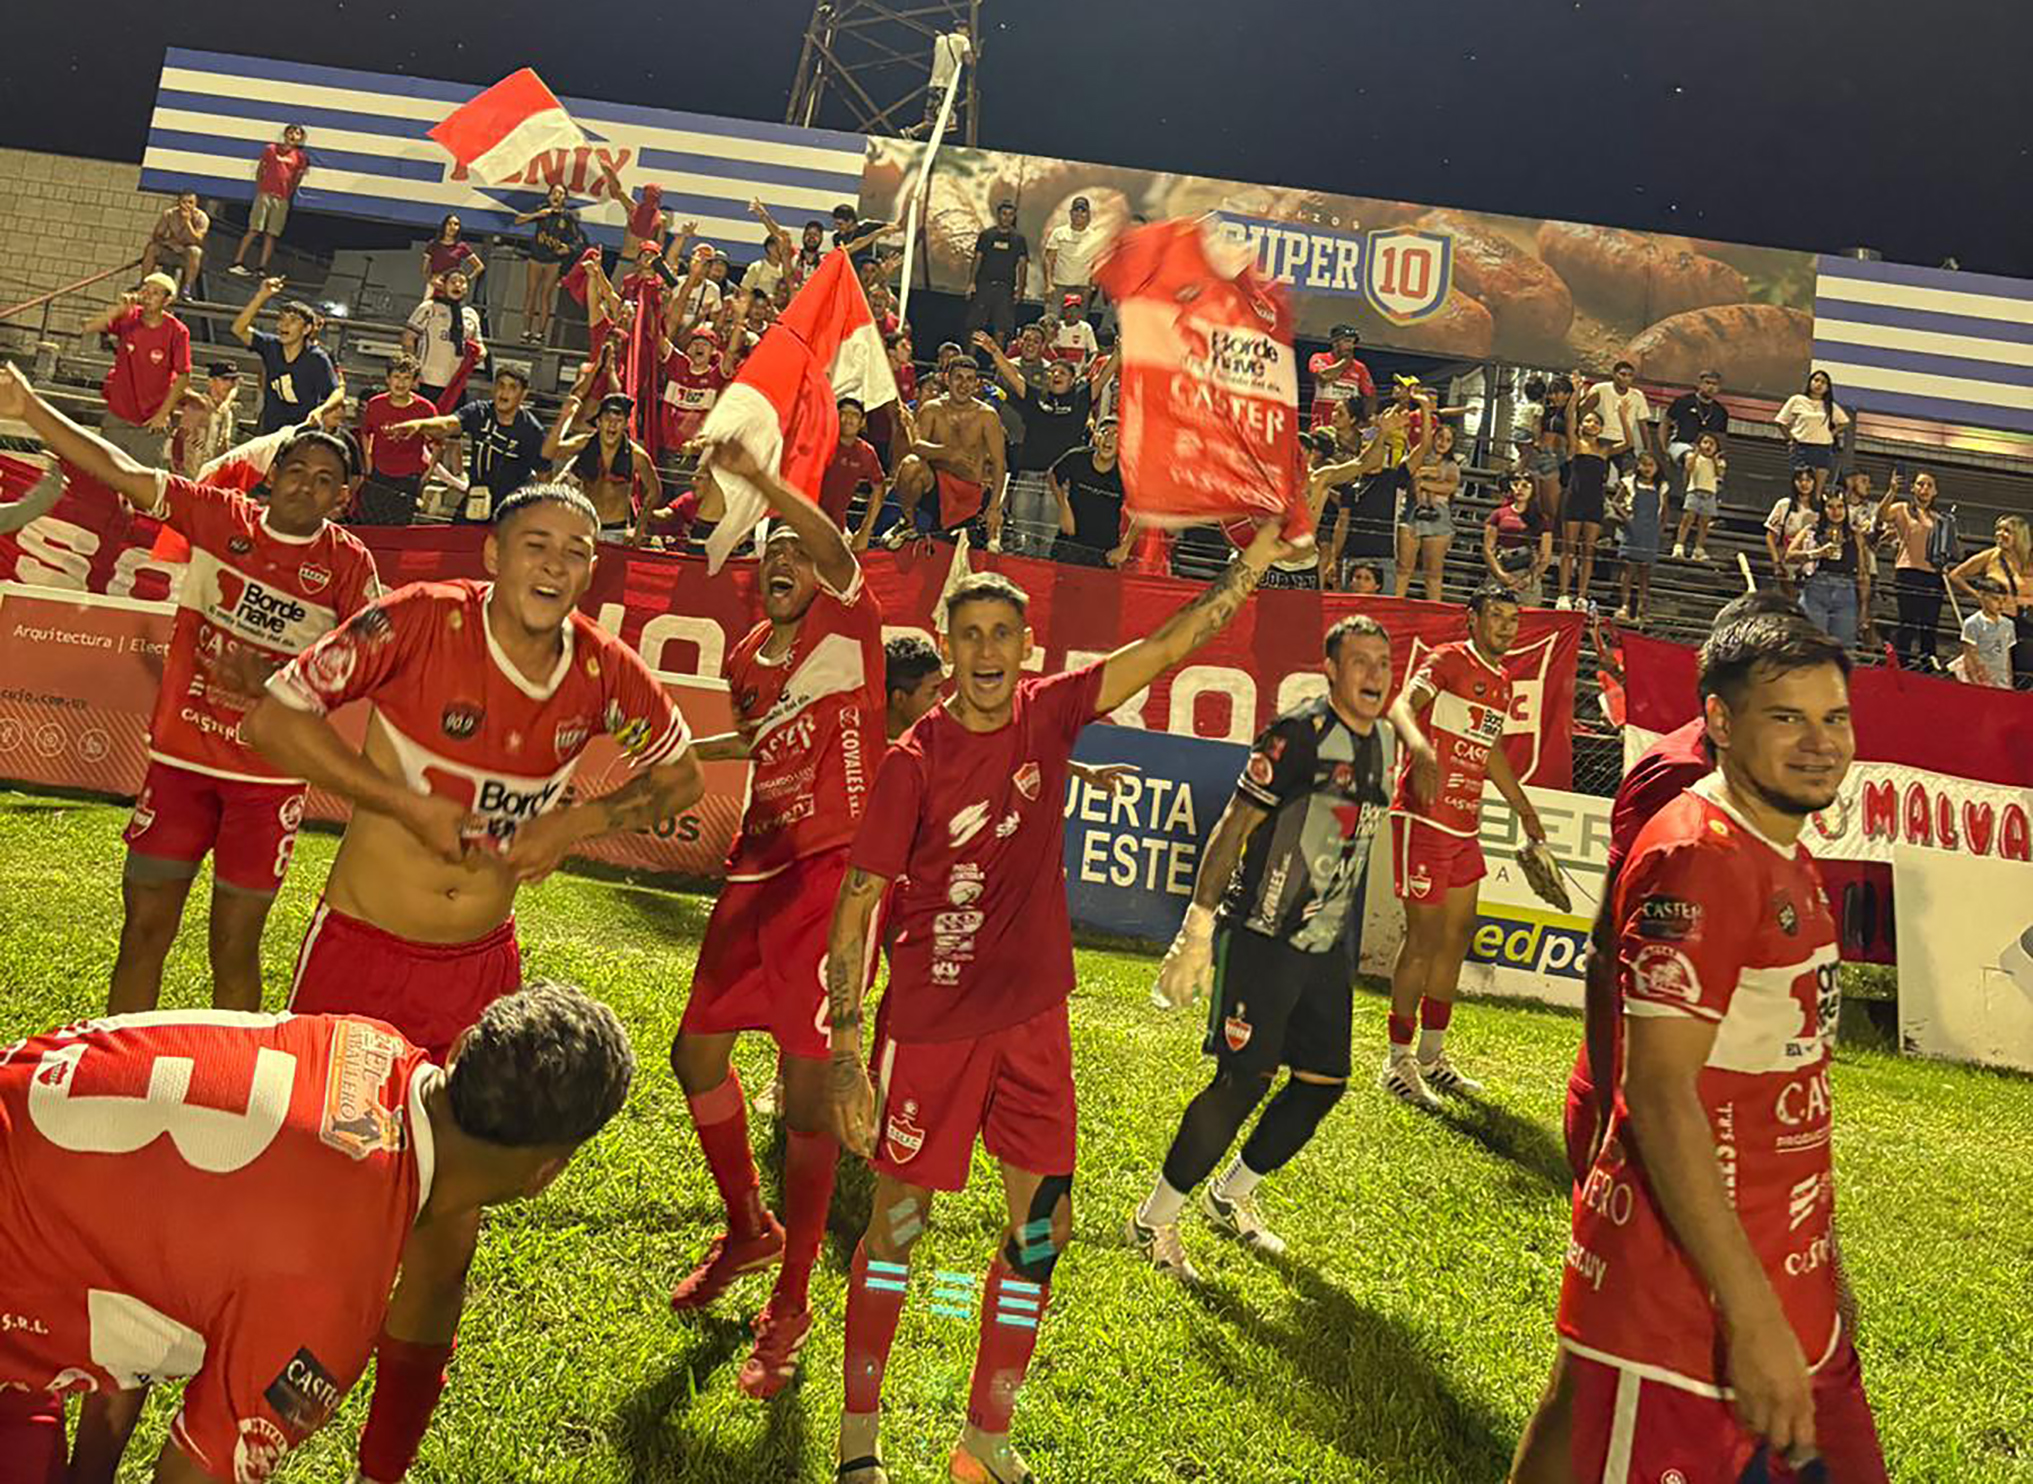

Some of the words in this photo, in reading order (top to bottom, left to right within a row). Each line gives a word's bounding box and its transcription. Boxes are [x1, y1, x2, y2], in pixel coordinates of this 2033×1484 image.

[450, 146, 632, 199] NIX
[1378, 246, 1432, 299] 10
[236, 604, 286, 634] nave
[244, 583, 306, 623] Borde
[13, 624, 113, 648] Arquitectura
[840, 728, 867, 795] COVALES
[1862, 778, 2032, 862] MALVA
[1081, 829, 1197, 895] ESTE
[1495, 865, 1510, 883] A
